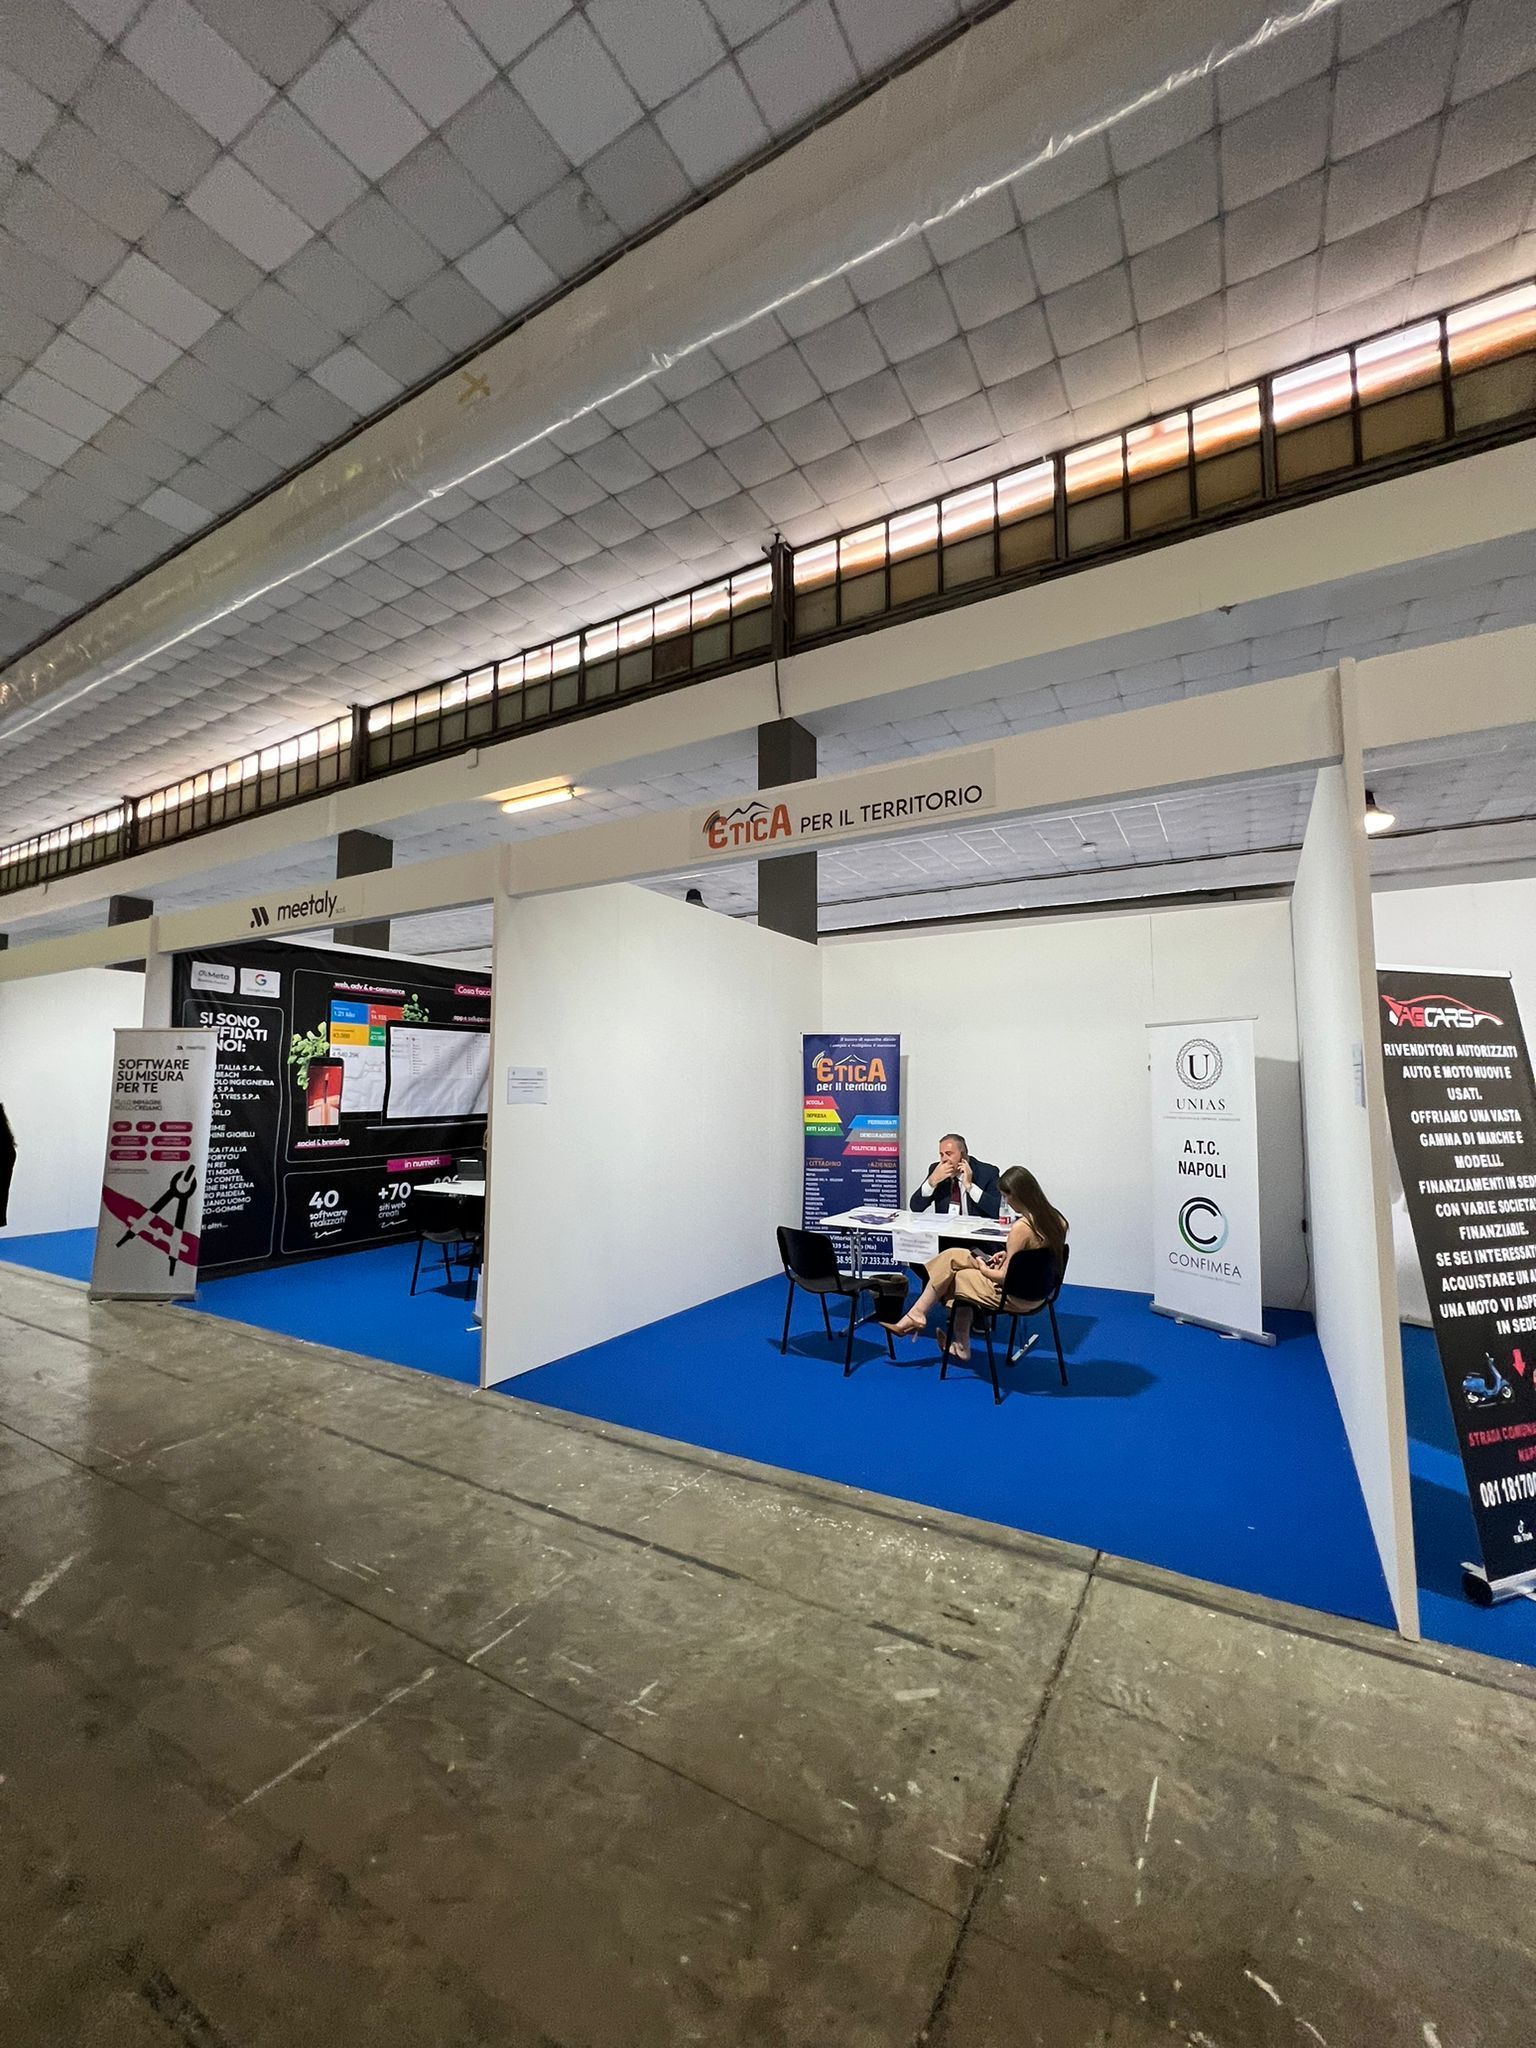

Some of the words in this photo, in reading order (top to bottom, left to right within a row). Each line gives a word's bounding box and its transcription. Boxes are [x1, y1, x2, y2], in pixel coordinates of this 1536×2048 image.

[707, 804, 792, 849] ETICA
[800, 813, 833, 834] PER
[839, 808, 855, 828] IL
[859, 784, 983, 823] TERRITORIO
[277, 889, 338, 921] meetaly
[368, 985, 405, 995] e-commerce
[457, 985, 475, 996] Cosa
[475, 986, 492, 997] facc
[200, 1012, 214, 1025] SI
[216, 1013, 260, 1029] SONO
[203, 1025, 268, 1042] FIDATI
[1383, 1043, 1454, 1058] RIVENDITORI
[1456, 1045, 1518, 1058] AUTORIZZATI
[117, 1058, 190, 1070] SOFTWARE
[816, 1057, 887, 1083] ETICA
[1187, 1054, 1210, 1081] U
[116, 1070, 134, 1082] SU
[135, 1070, 184, 1082] MISURA
[1402, 1066, 1432, 1079] AUTO
[1434, 1066, 1442, 1079] E
[1442, 1066, 1474, 1079] MOTO
[1475, 1066, 1504, 1079] NUOVI
[1505, 1066, 1512, 1079] E
[116, 1082, 140, 1093] PER
[142, 1082, 158, 1093] TE
[816, 1082, 832, 1093] per
[835, 1082, 841, 1091] il
[845, 1082, 887, 1092] territorio
[1447, 1087, 1483, 1101] USATI.
[1176, 1098, 1226, 1111] UNIAS
[1410, 1109, 1468, 1124] OFFRIAMO
[1469, 1109, 1491, 1123] UNA
[1490, 1109, 1522, 1122] VASTA
[321, 1138, 350, 1147] branding
[1419, 1132, 1462, 1147] GAMMA
[1463, 1132, 1475, 1145] DI
[1477, 1131, 1515, 1145] MARCHE
[1516, 1131, 1524, 1144] E
[1184, 1139, 1220, 1156] A.T.C.
[404, 1159, 412, 1168] in
[1454, 1153, 1504, 1169] MODELLI.
[216, 1168, 240, 1176] MODA
[1178, 1160, 1227, 1179] NAPOLI
[229, 1182, 255, 1190] SCENA
[378, 1182, 412, 1200] +70
[1418, 1175, 1506, 1195] FINANZIAMENTI
[1506, 1175, 1517, 1189] IN
[227, 1196, 251, 1204] UOMO
[309, 1189, 340, 1209] 40
[378, 1203, 390, 1212] siti
[390, 1201, 407, 1210] web
[309, 1208, 348, 1221] software
[378, 1209, 400, 1220] creati
[1435, 1203, 1461, 1218] CON
[1461, 1200, 1498, 1216] VARIE
[309, 1216, 346, 1229] realizzati
[1459, 1221, 1530, 1241] FINANZIARIE.
[1168, 1251, 1243, 1279] CONFIMEA
[1436, 1252, 1453, 1268] SE
[1453, 1250, 1473, 1266] SEI
[1442, 1271, 1516, 1293] ACQUISTARE
[1516, 1271, 1529, 1285] UN
[1439, 1302, 1467, 1320] UNA
[1466, 1299, 1499, 1317] MOTO
[1500, 1297, 1515, 1313] VI
[1496, 1319, 1512, 1335] IN
[1480, 1479, 1502, 1508] 081
